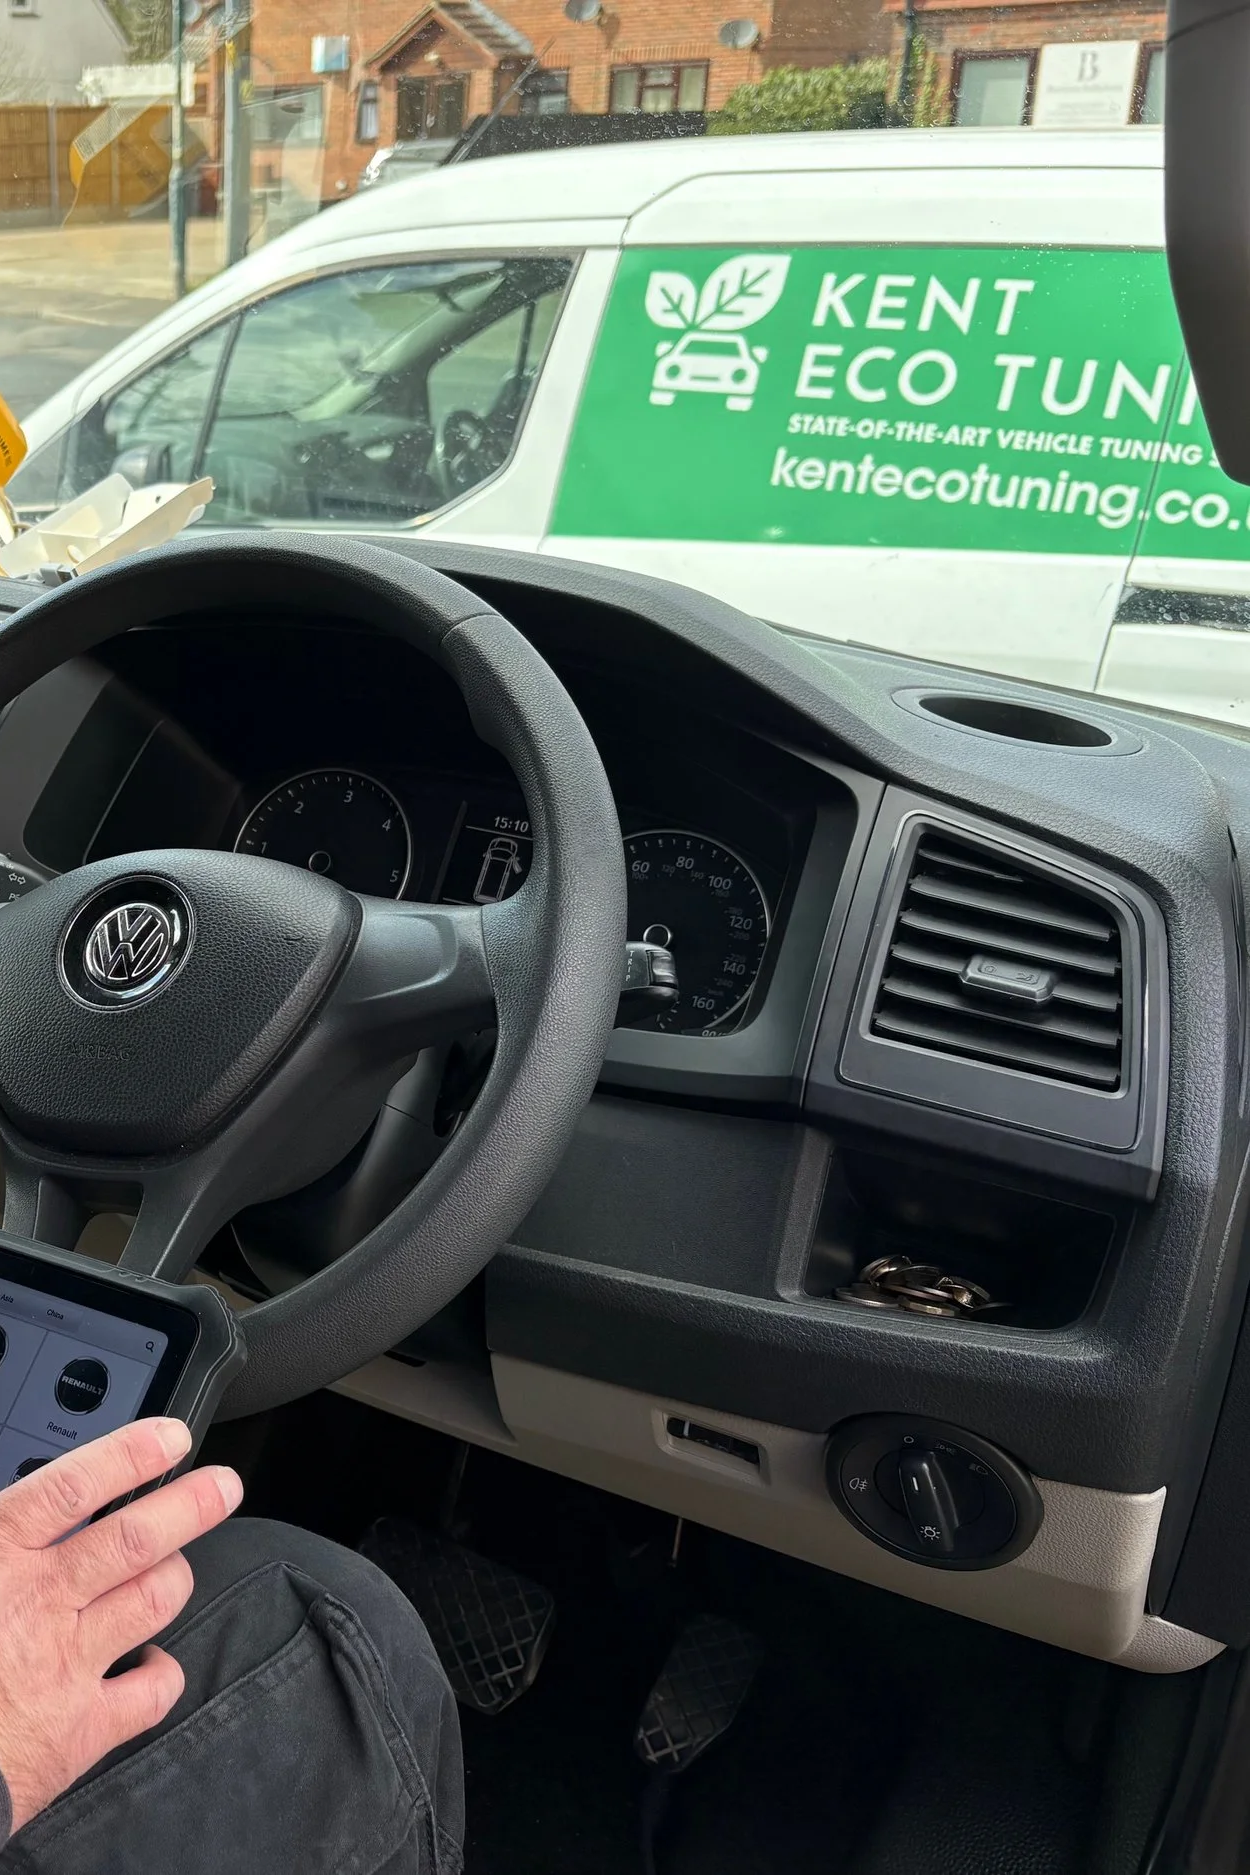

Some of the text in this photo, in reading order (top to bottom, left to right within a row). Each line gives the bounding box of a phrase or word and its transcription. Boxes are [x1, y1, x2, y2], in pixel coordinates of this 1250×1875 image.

[811, 272, 1035, 336] KENT
[794, 344, 958, 406] ECO
[787, 412, 992, 448] STATE-OF-THE-ART
[998, 428, 1093, 456] VEHICLE
[1099, 436, 1203, 466] TUNING
[770, 447, 1250, 530] kentecotuning.co.
[343, 790, 353, 803] 3
[294, 801, 304, 815] 2
[382, 819, 391, 831] 4
[494, 815, 529, 833] 15:10
[260, 841, 268, 854] 1
[631, 860, 650, 873] 60
[675, 855, 694, 870] 80
[389, 869, 399, 883] 5
[708, 875, 732, 890] 100
[729, 915, 753, 931] 120
[625, 950, 635, 982] TRIP
[722, 960, 746, 976] 140
[691, 995, 716, 1011] 160
[0, 1293, 14, 1304] Asia
[46, 1308, 64, 1321] China
[61, 1374, 104, 1396] RENAULT
[46, 1421, 78, 1440] Renault
